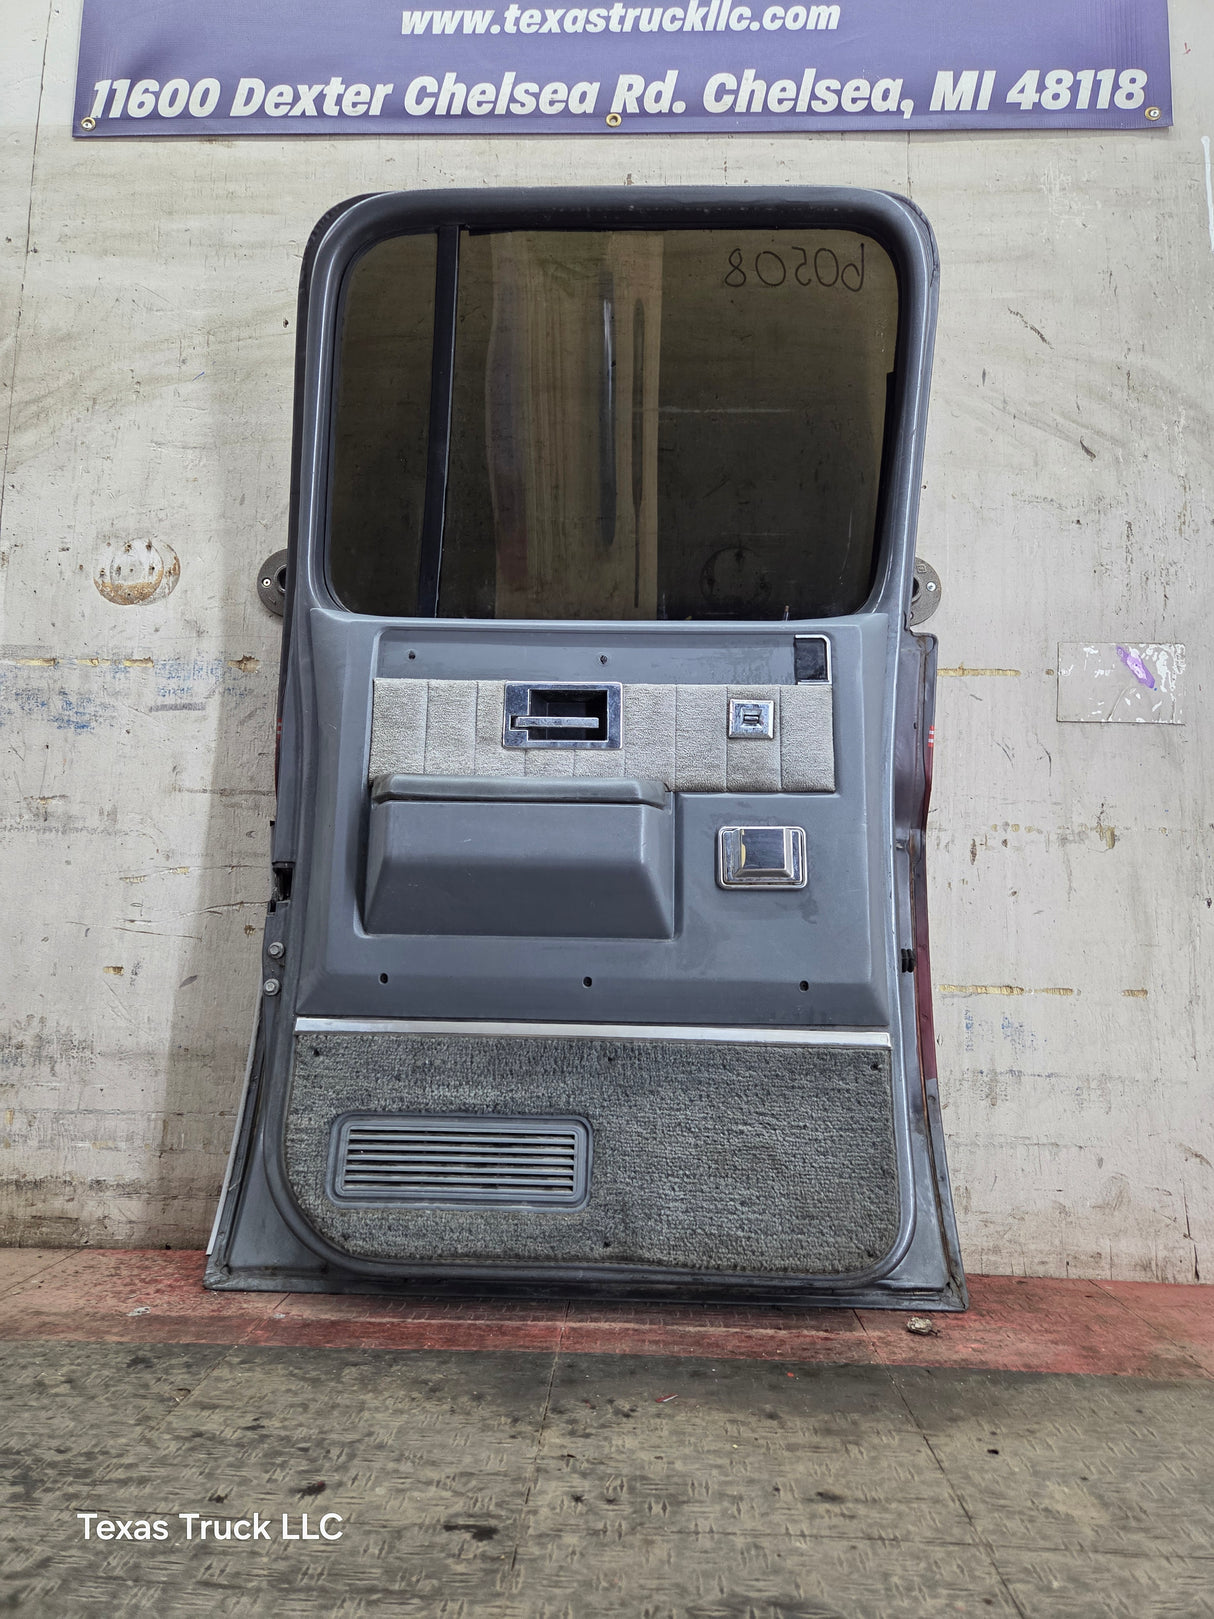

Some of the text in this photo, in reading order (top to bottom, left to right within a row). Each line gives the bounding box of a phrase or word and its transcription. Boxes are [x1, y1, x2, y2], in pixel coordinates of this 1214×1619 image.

[401, 0, 841, 34] www.texastruckllc.com
[92, 68, 1148, 119] 11600 Dexter Chelsea Rd. Chelsea, MI 48118
